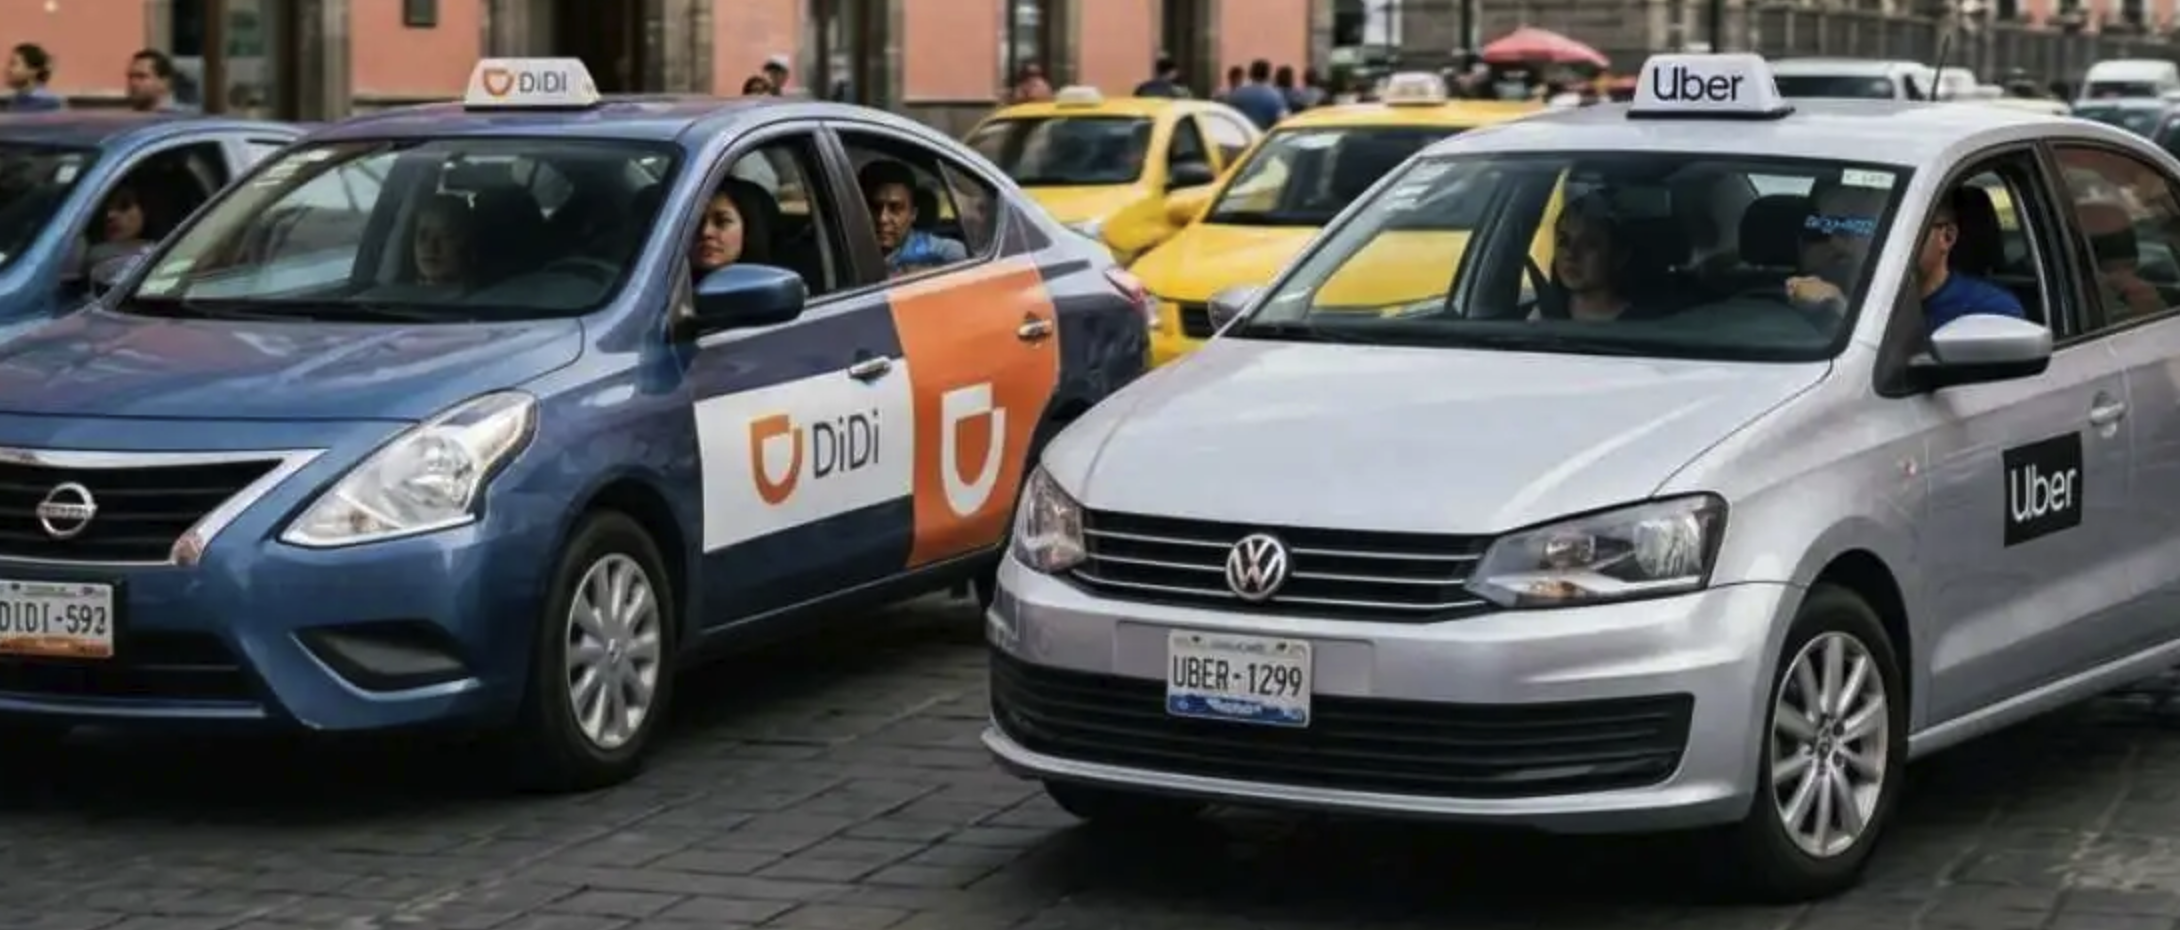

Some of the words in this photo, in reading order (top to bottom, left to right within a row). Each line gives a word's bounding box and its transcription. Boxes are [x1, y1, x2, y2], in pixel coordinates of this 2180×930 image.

[1653, 65, 1745, 102] Uber
[812, 407, 879, 479] DiDi
[2011, 462, 2077, 522] Uber
